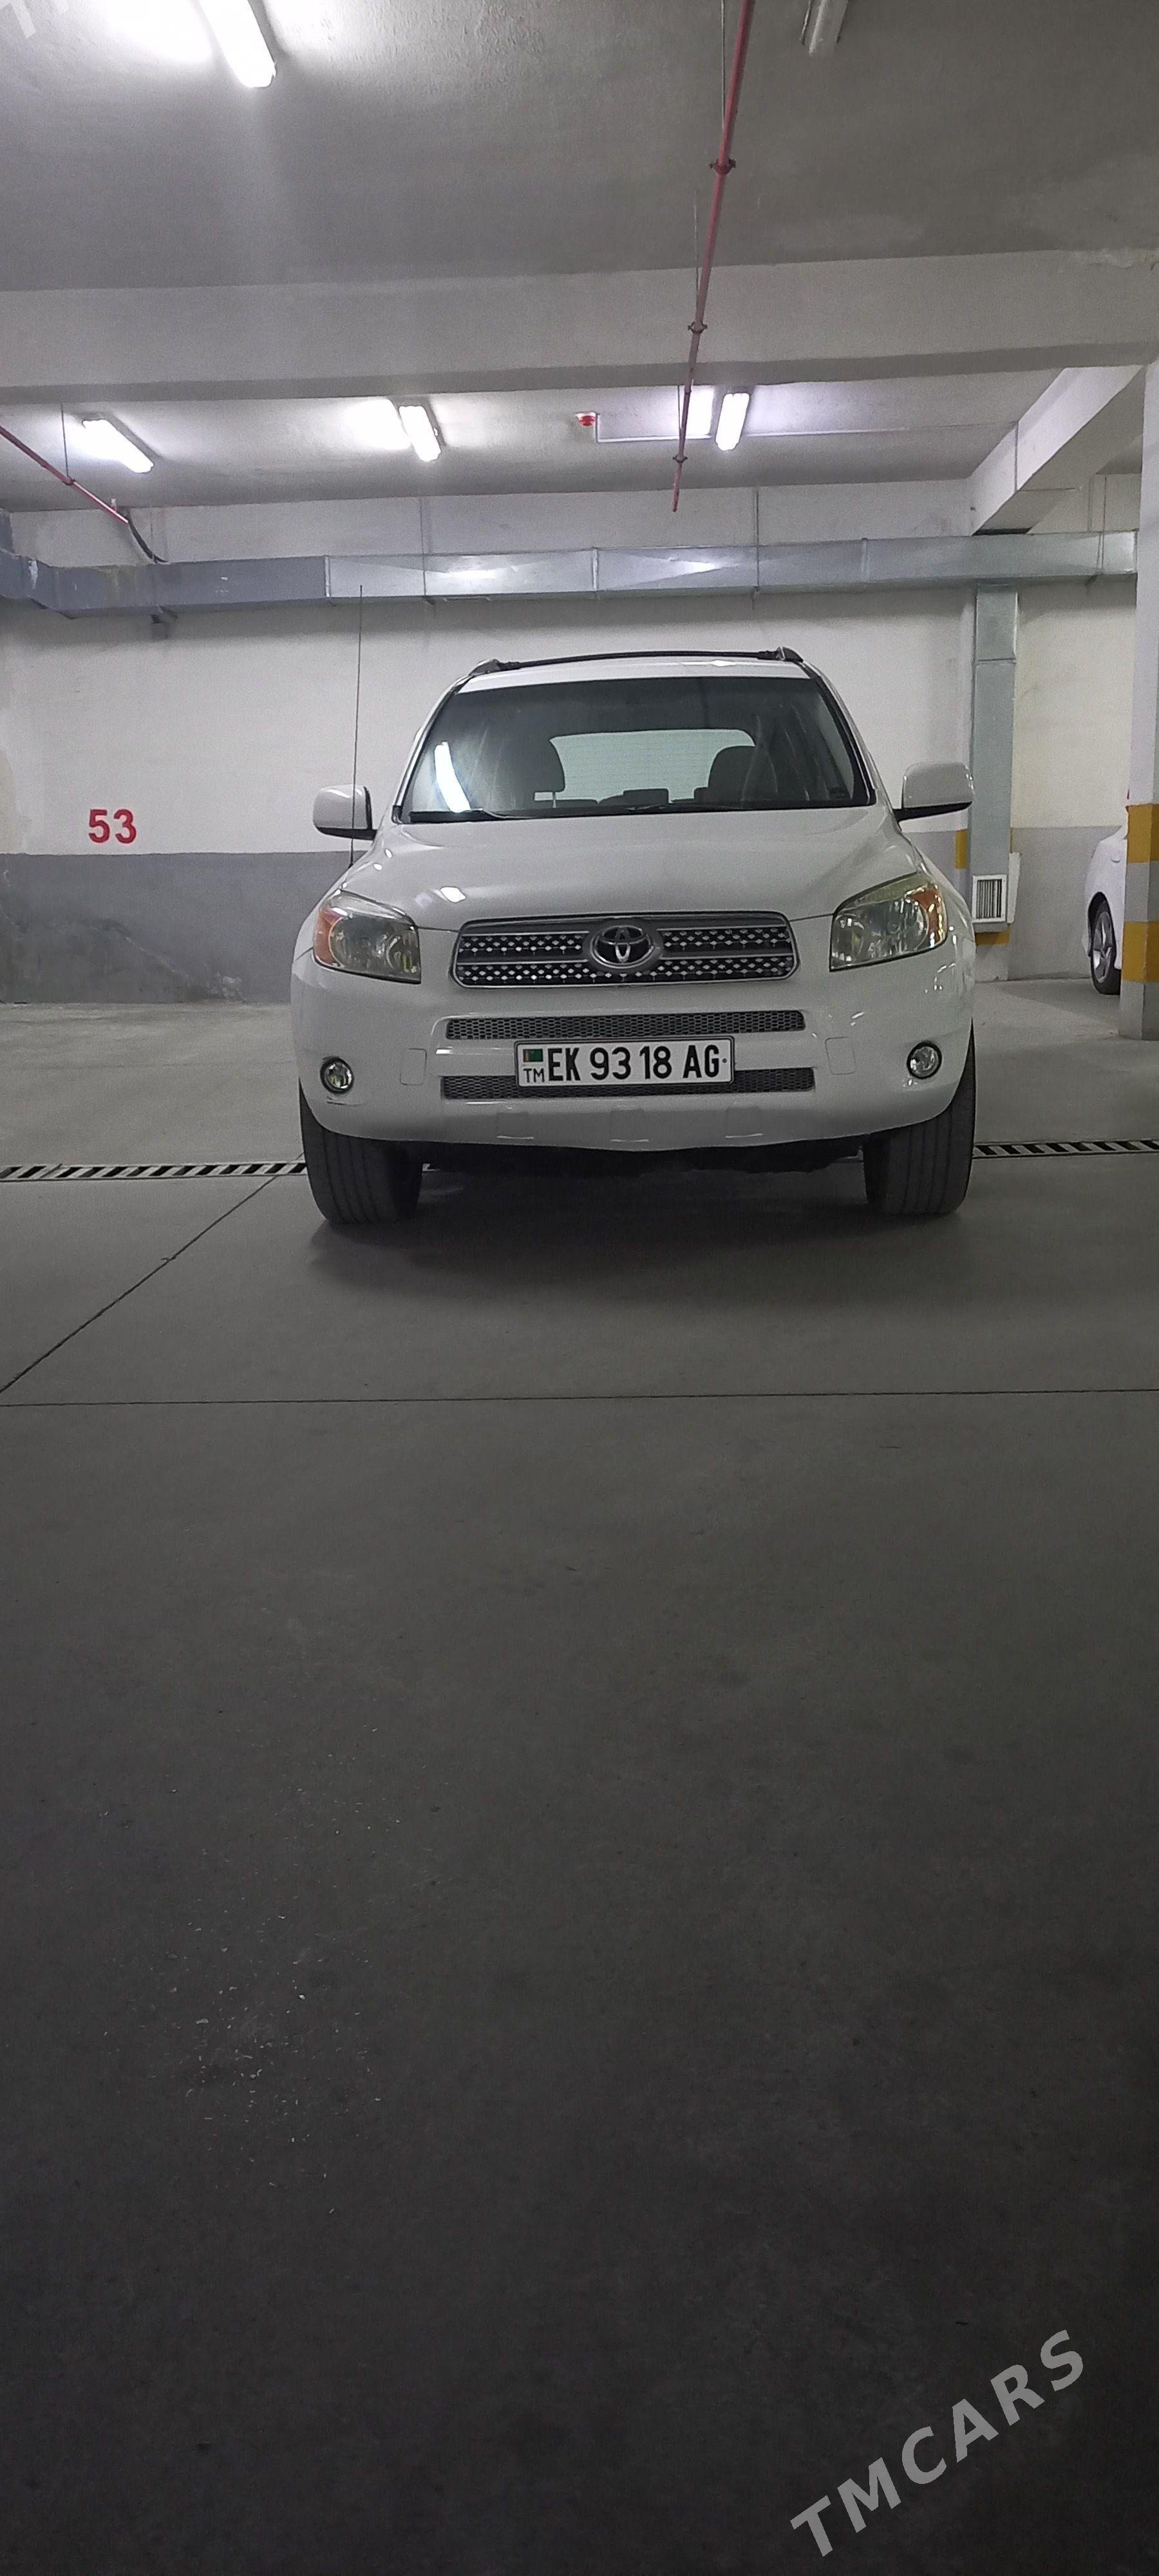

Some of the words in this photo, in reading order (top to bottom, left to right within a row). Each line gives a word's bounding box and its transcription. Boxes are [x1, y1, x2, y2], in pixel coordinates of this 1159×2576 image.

[89, 809, 137, 844] 53
[523, 1068, 545, 1083] TM
[547, 1047, 581, 1081] EK
[590, 1046, 632, 1080] 93
[639, 1045, 672, 1079] 18
[683, 1044, 720, 1078] AG
